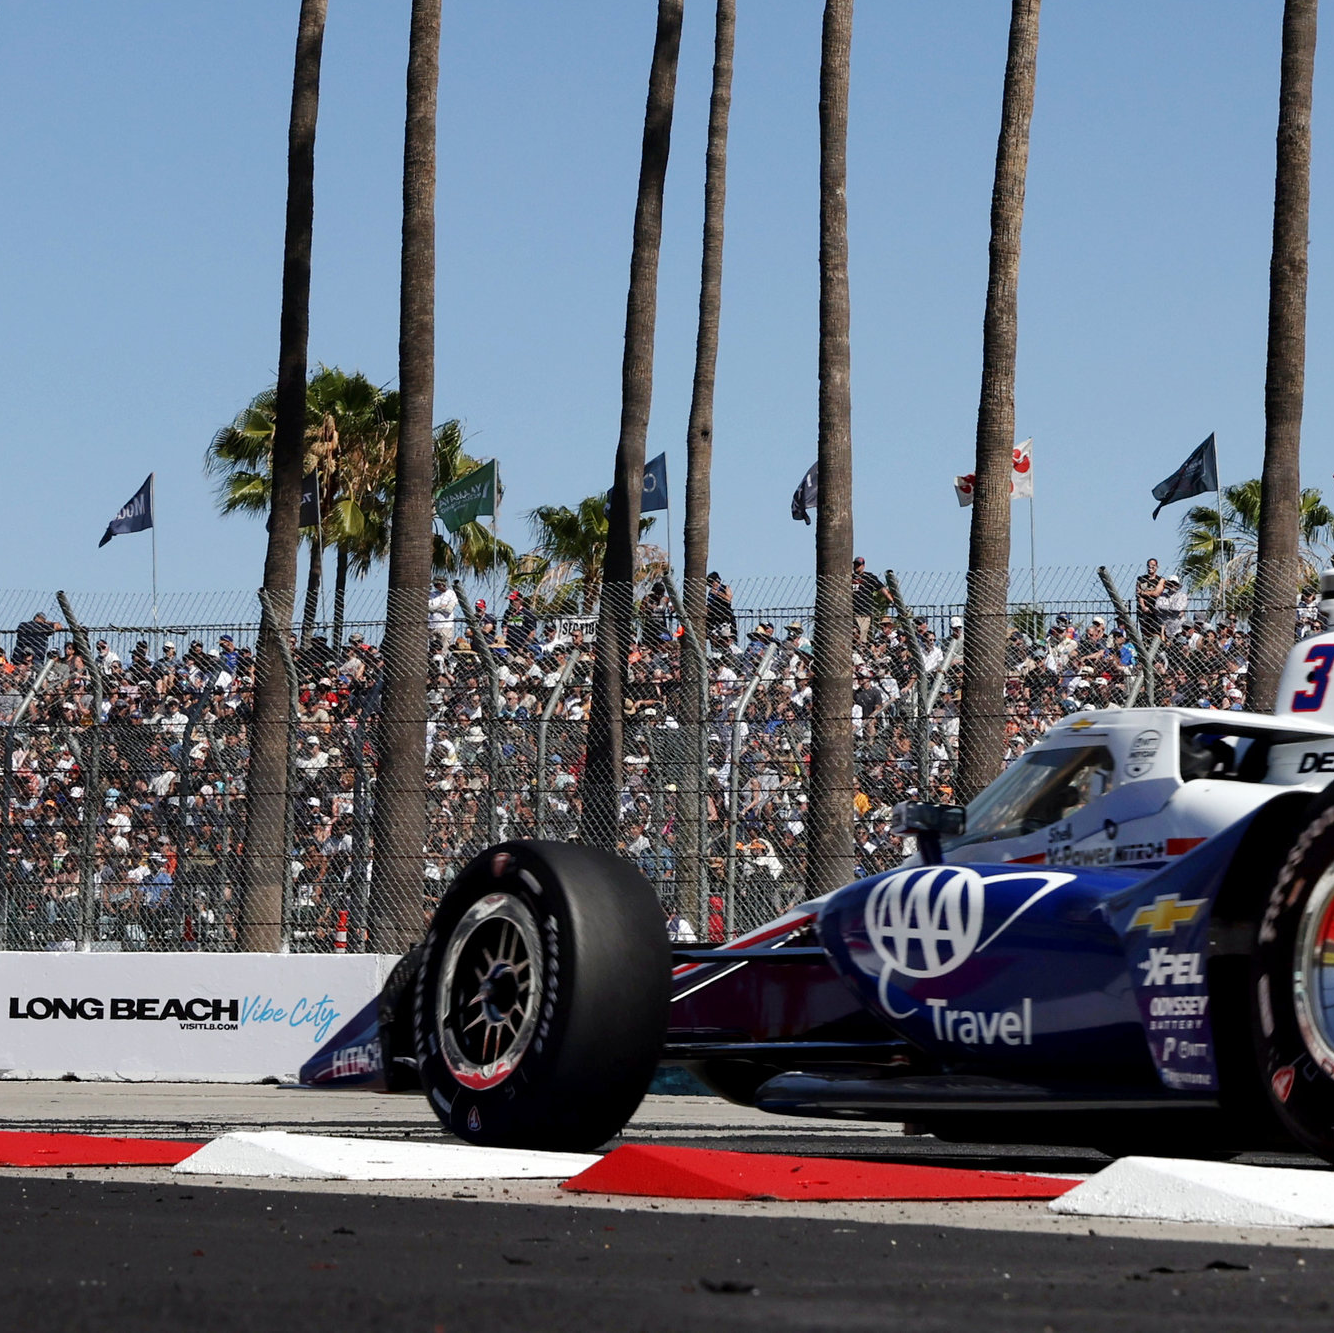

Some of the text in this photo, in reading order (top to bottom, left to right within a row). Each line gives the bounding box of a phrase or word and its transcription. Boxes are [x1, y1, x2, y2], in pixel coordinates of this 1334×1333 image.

[562, 622, 597, 636] SECTIO
[866, 866, 985, 978] AAA
[1142, 947, 1204, 986] XPEL
[9, 994, 341, 1042] LONG BEACH Vibe City
[179, 1023, 239, 1031] VISITLB.COM
[925, 997, 1033, 1046] Travel
[332, 1040, 385, 1079] HITACH
